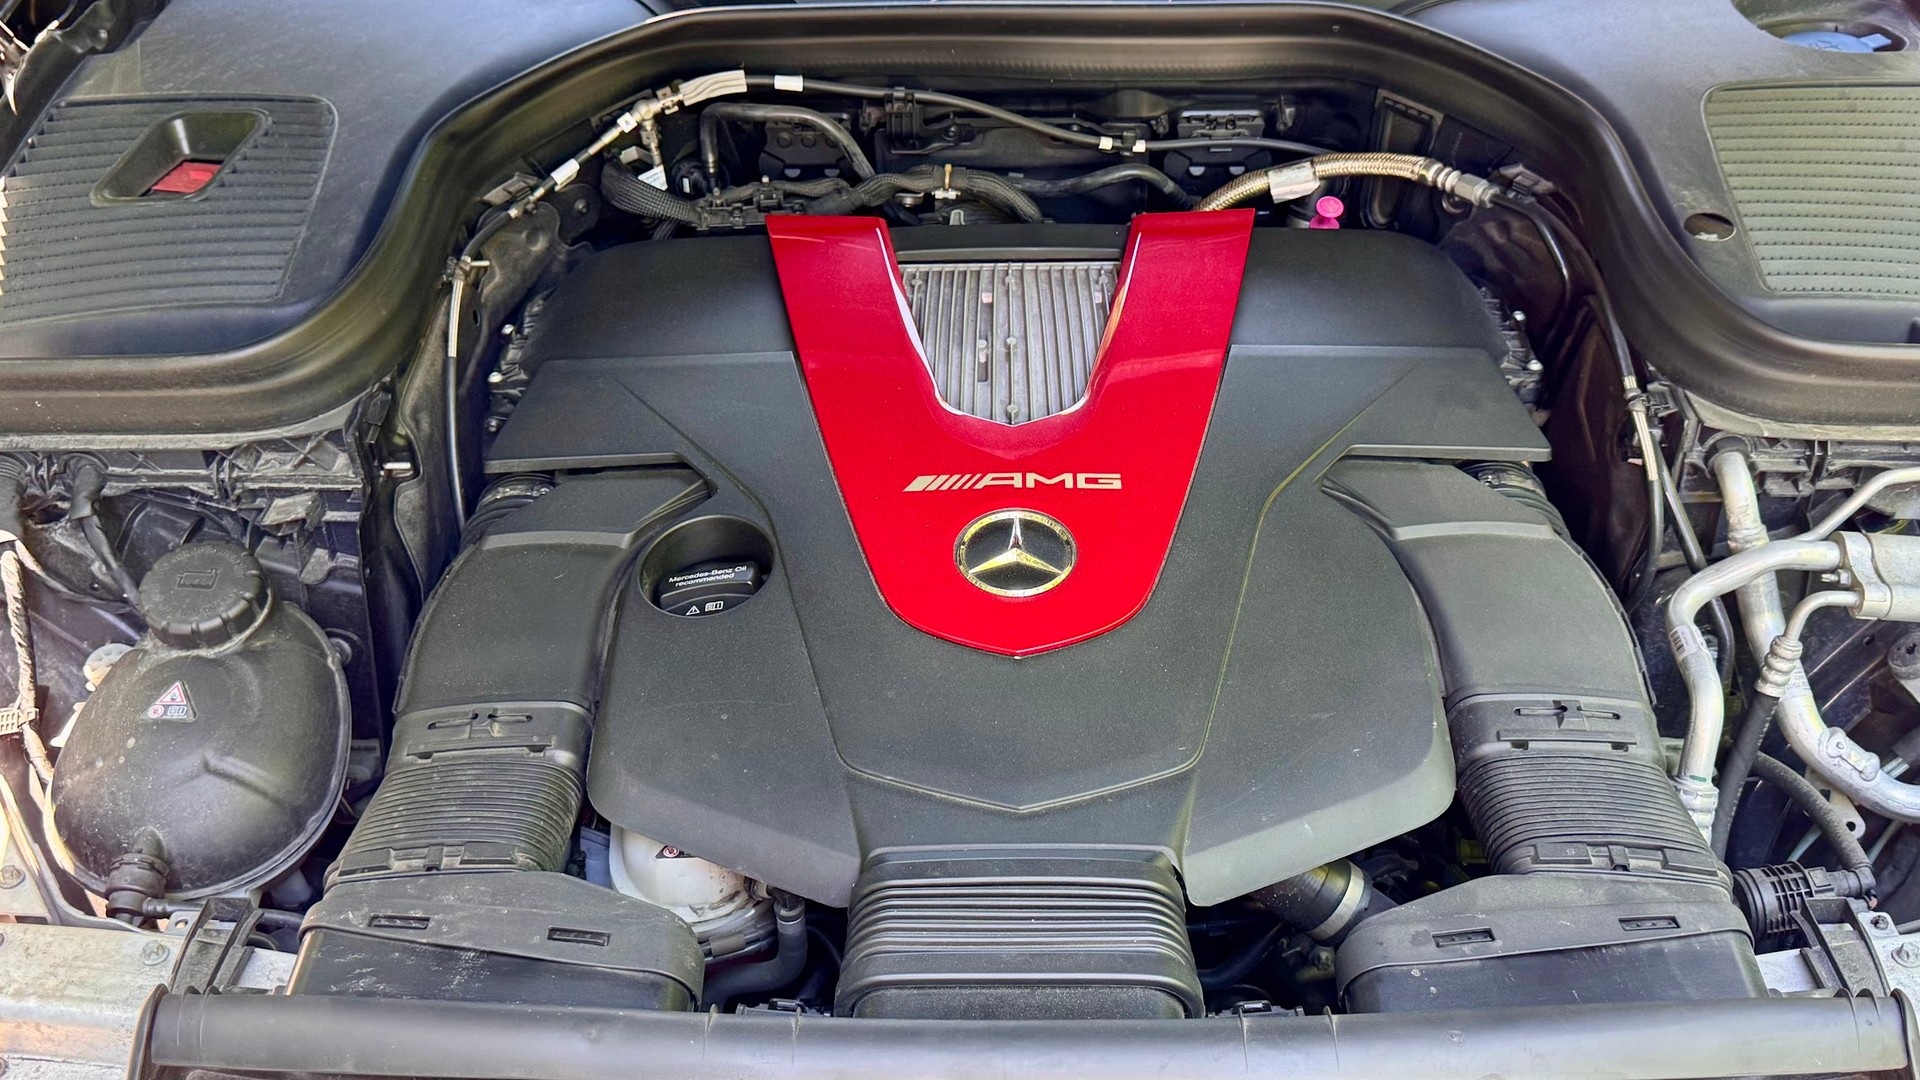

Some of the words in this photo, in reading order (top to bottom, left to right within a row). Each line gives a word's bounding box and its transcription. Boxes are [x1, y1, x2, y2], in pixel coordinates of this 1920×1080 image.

[973, 472, 1122, 490] AMG
[668, 568, 733, 583] Mercedes-Benz
[675, 573, 735, 587] recommended
